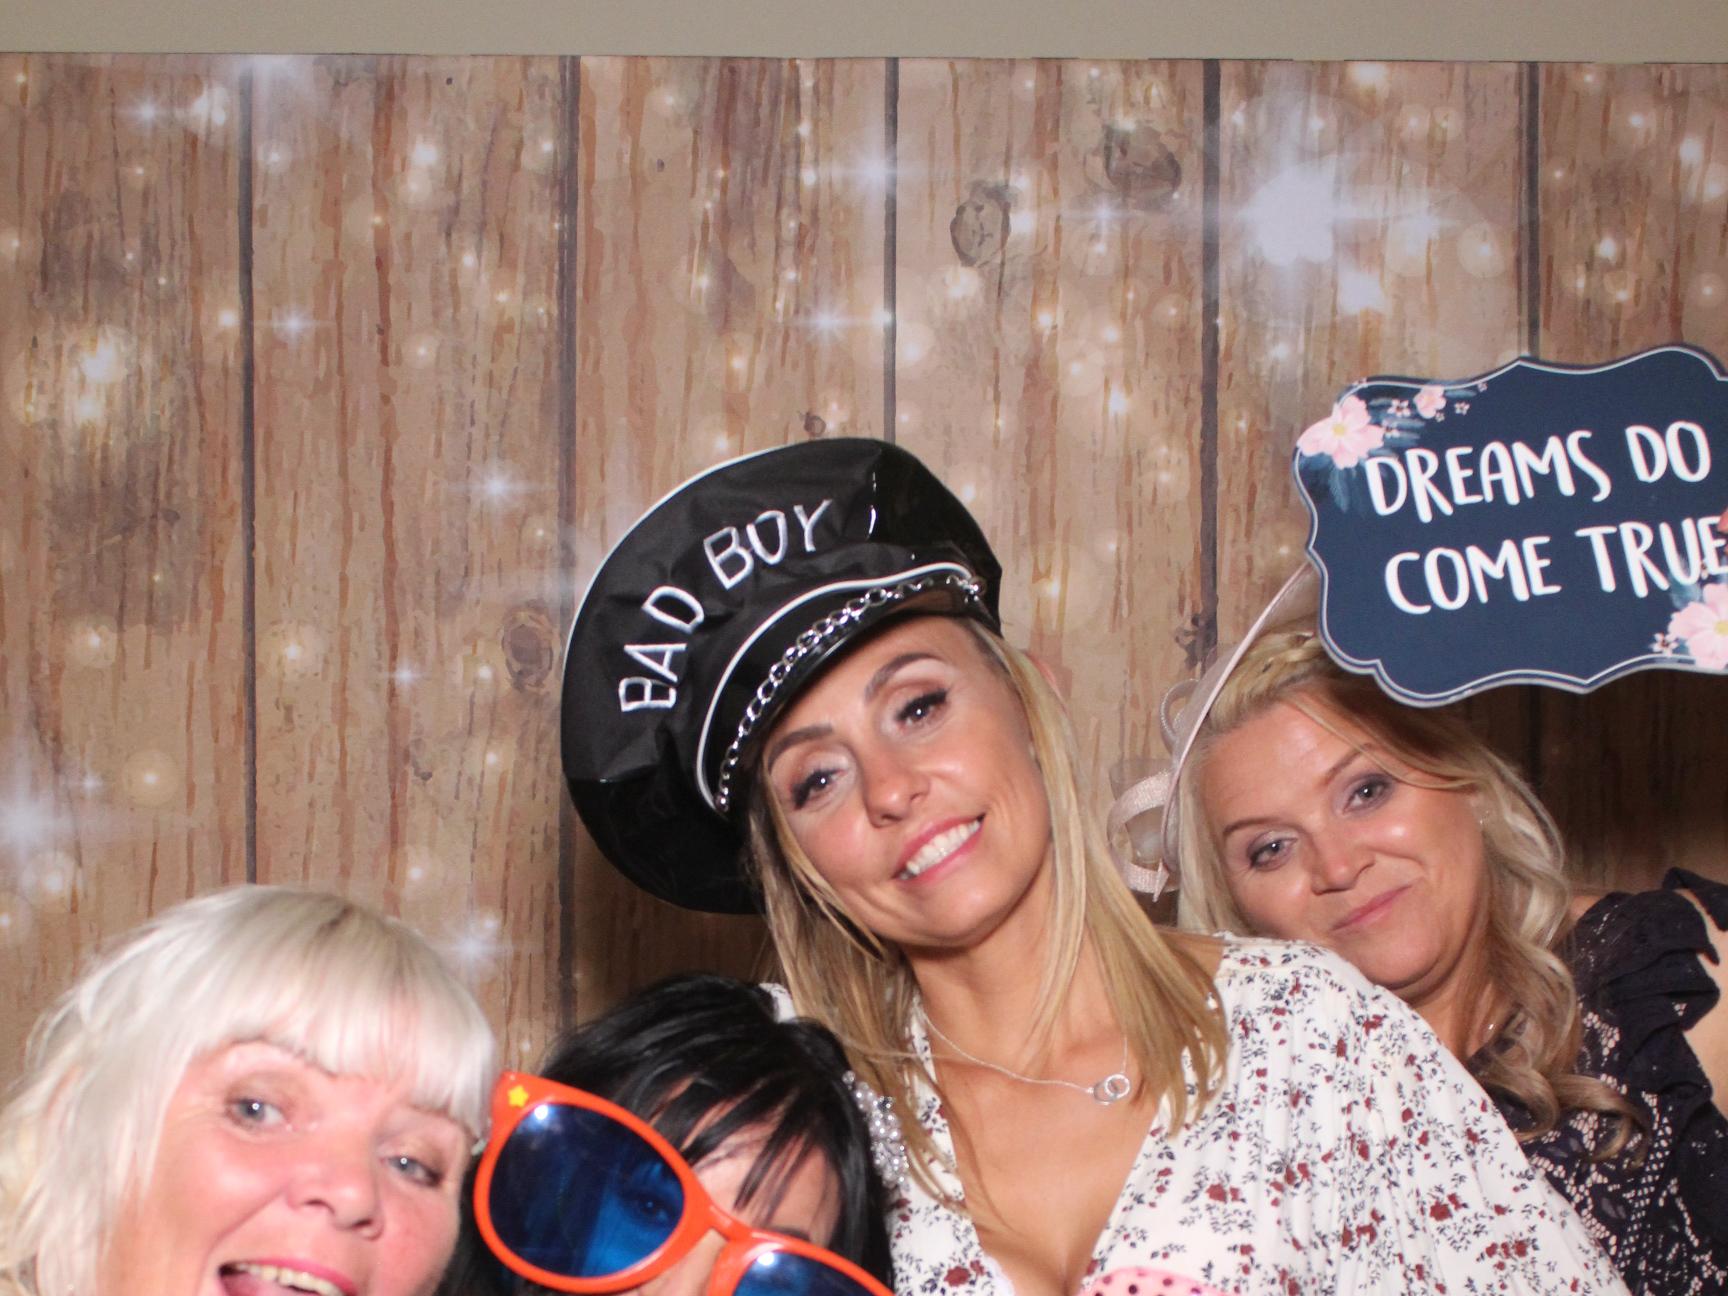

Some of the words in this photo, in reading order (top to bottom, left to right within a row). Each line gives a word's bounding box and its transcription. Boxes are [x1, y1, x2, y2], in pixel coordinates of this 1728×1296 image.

[1364, 430, 1612, 523] DREAMS
[1625, 421, 1711, 483] DO
[618, 585, 705, 713] BAD
[703, 499, 832, 591] BOY
[1384, 536, 1562, 615] COME
[1574, 516, 1728, 598] TRUE
